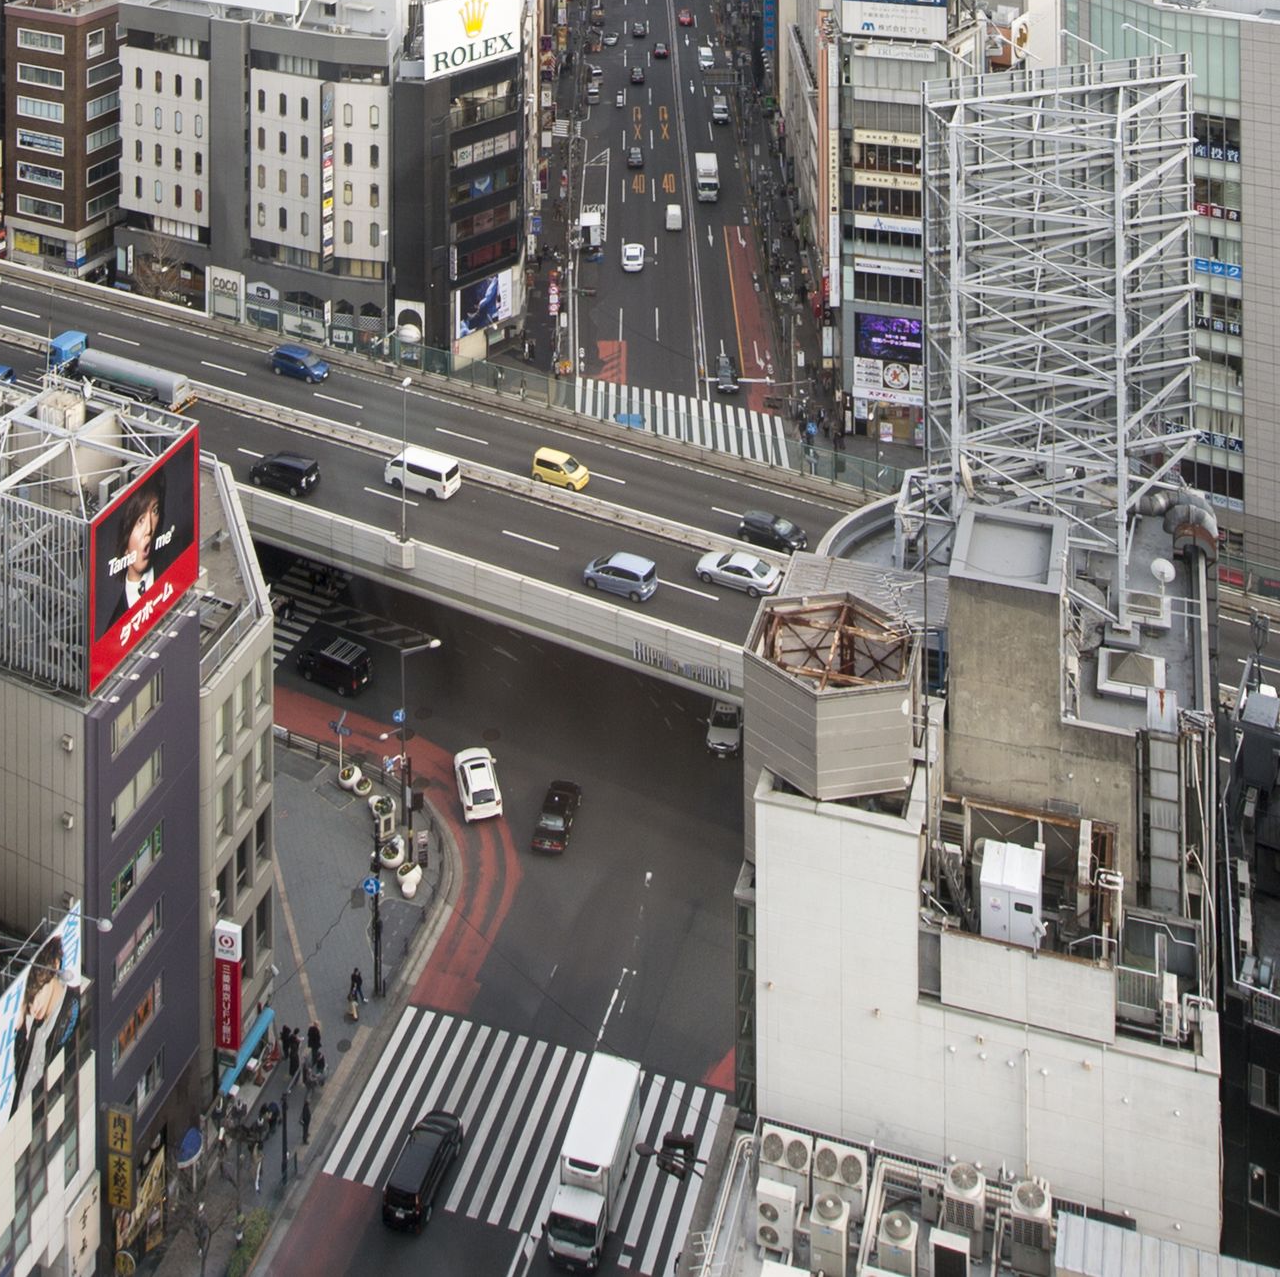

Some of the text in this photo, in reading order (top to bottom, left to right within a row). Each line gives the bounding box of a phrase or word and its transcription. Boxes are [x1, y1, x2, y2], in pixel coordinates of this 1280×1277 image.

[878, 24, 929, 35] 株式会社マリモ
[432, 31, 515, 73] ROLEX
[631, 173, 646, 194] 40
[662, 173, 676, 194] 40
[212, 276, 239, 293] COCO
[108, 550, 138, 577] Tama
[119, 582, 174, 646] タマホーム
[112, 1114, 128, 1151] 肉汁
[112, 1157, 128, 1205] 水餃子
